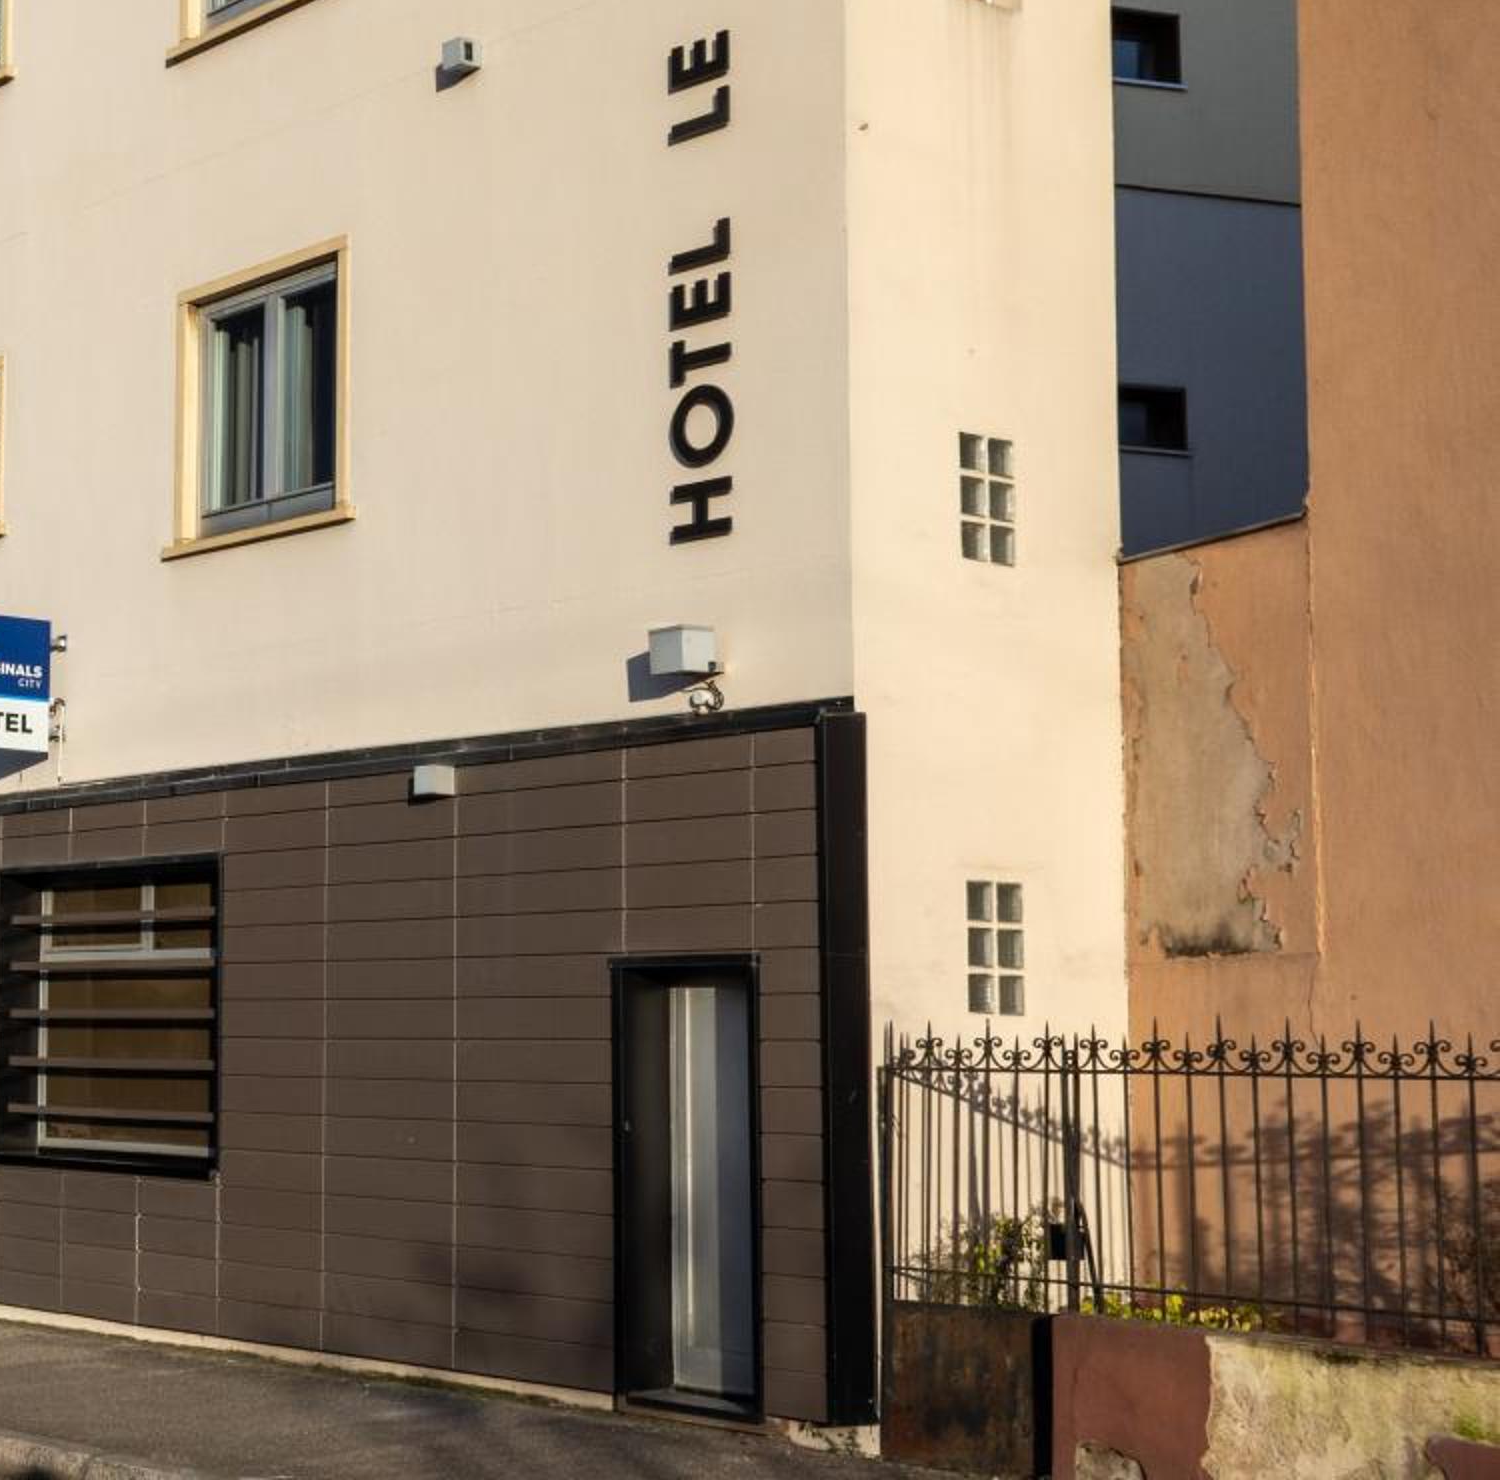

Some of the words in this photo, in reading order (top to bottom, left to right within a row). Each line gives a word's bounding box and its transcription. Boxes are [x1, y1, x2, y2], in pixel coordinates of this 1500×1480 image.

[667, 29, 731, 147] LE
[668, 216, 735, 546] HOTEL
[17, 678, 43, 689] CITY
